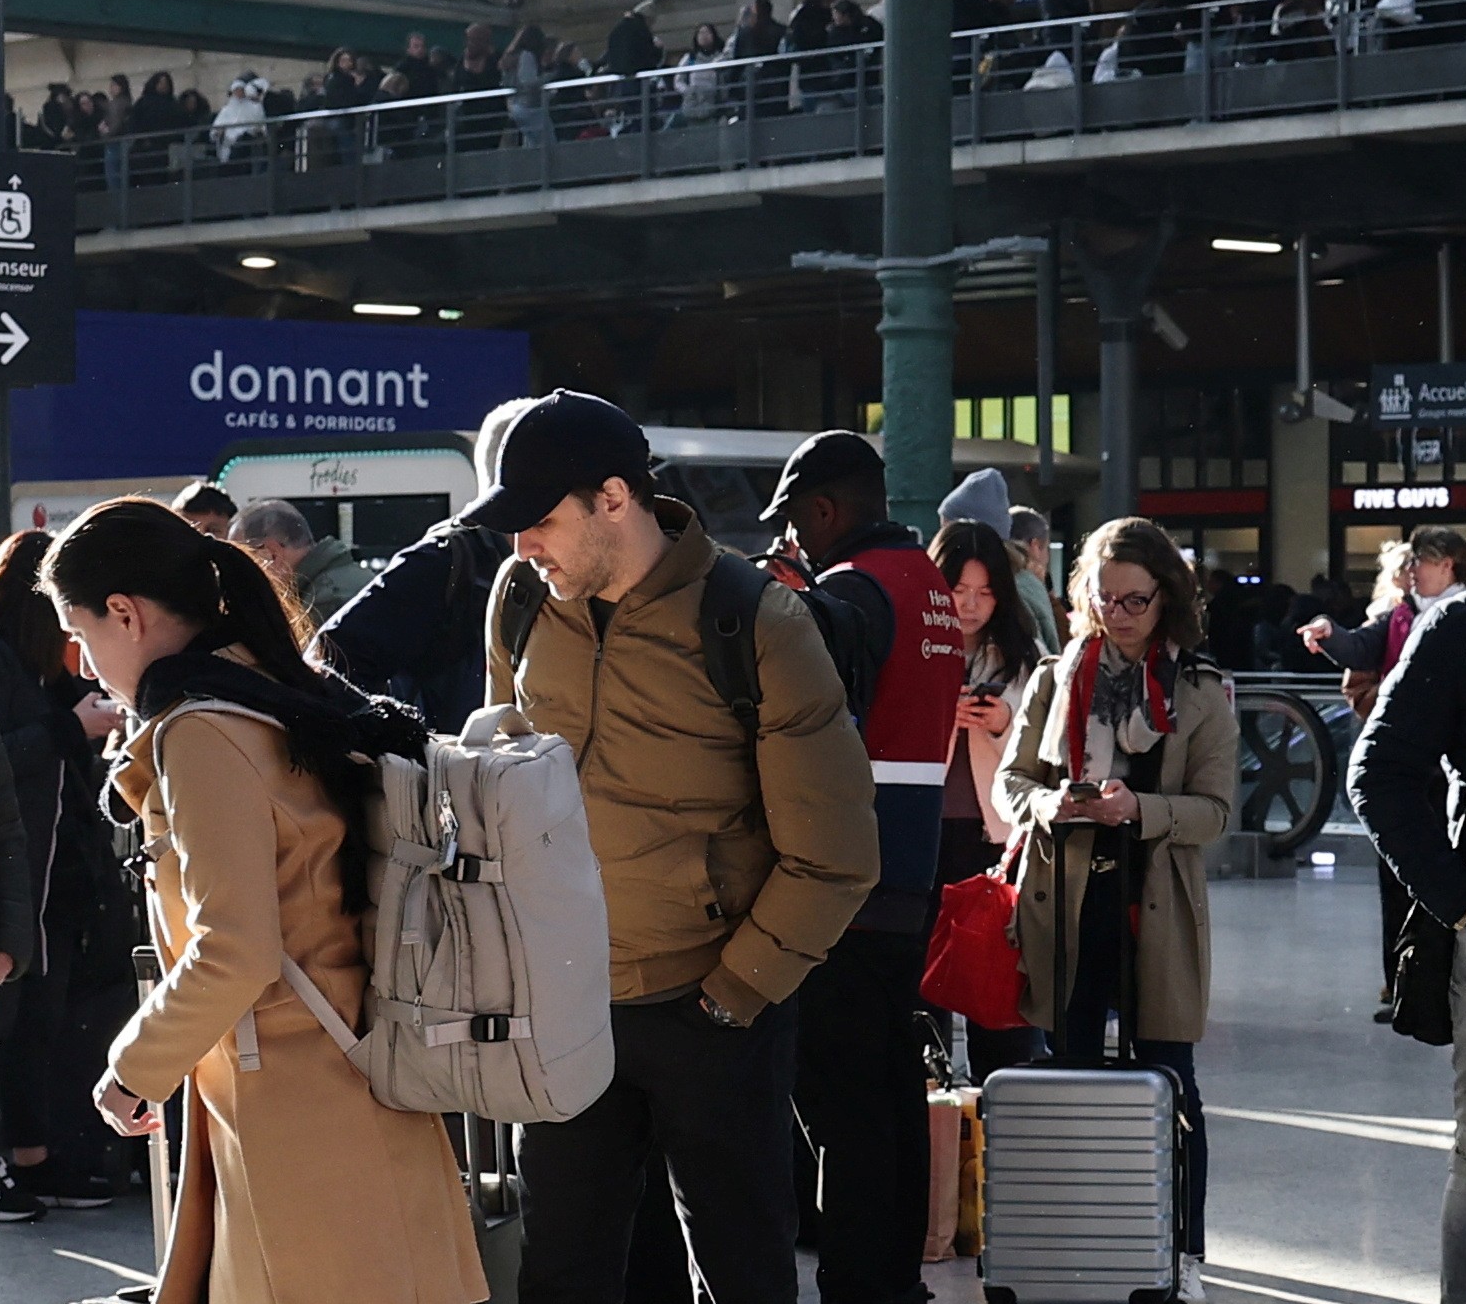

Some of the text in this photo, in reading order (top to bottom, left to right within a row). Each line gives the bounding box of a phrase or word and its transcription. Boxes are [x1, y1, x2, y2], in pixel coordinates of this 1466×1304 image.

[189, 349, 430, 409] donnant
[224, 410, 397, 433] CAFÉS & PORRIDGES
[1353, 486, 1450, 510] FIVE GUYS
[929, 590, 951, 608] Here
[932, 610, 951, 631] help
